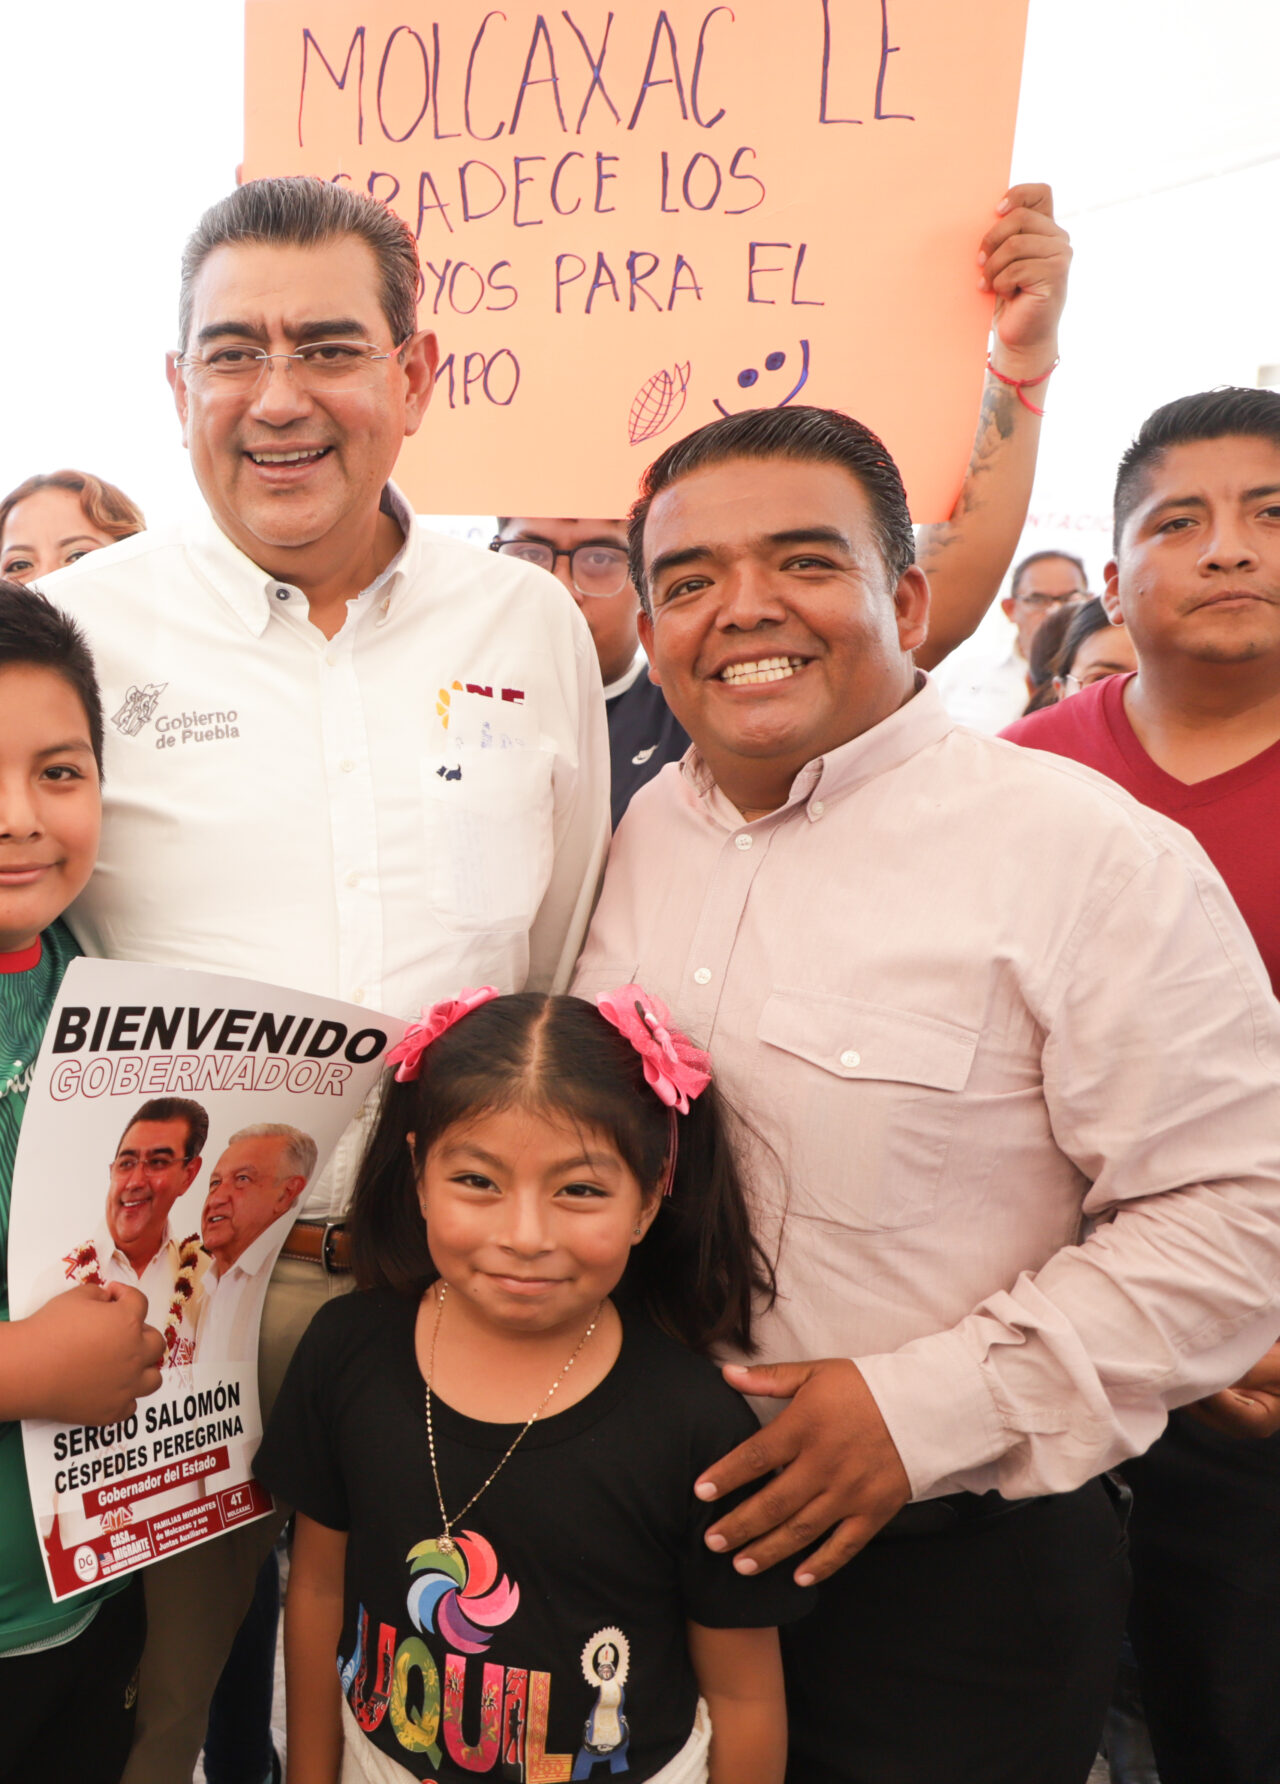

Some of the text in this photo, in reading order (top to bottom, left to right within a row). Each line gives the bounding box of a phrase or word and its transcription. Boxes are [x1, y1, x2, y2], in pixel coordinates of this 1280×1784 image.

[298, 0, 916, 146] MOLCAXAC LE
[661, 146, 765, 214] LOS
[417, 242, 825, 315] YOS PARA EL
[155, 708, 239, 734] Gobierno
[155, 723, 241, 750] de Puebla
[52, 1006, 387, 1064] BIENVENIDO
[49, 1054, 353, 1101] GOBERNADOR
[53, 1380, 240, 1461] SERGIO SALOMÓN
[54, 1415, 244, 1494] CÉSPEDES PEREGRINA
[98, 1454, 217, 1506] Gobernador del Estado
[230, 1491, 242, 1506] 4T
[110, 1530, 130, 1548] CASA
[153, 1501, 216, 1531] FAMILIAS MIGRANTES
[78, 1554, 93, 1569] DG
